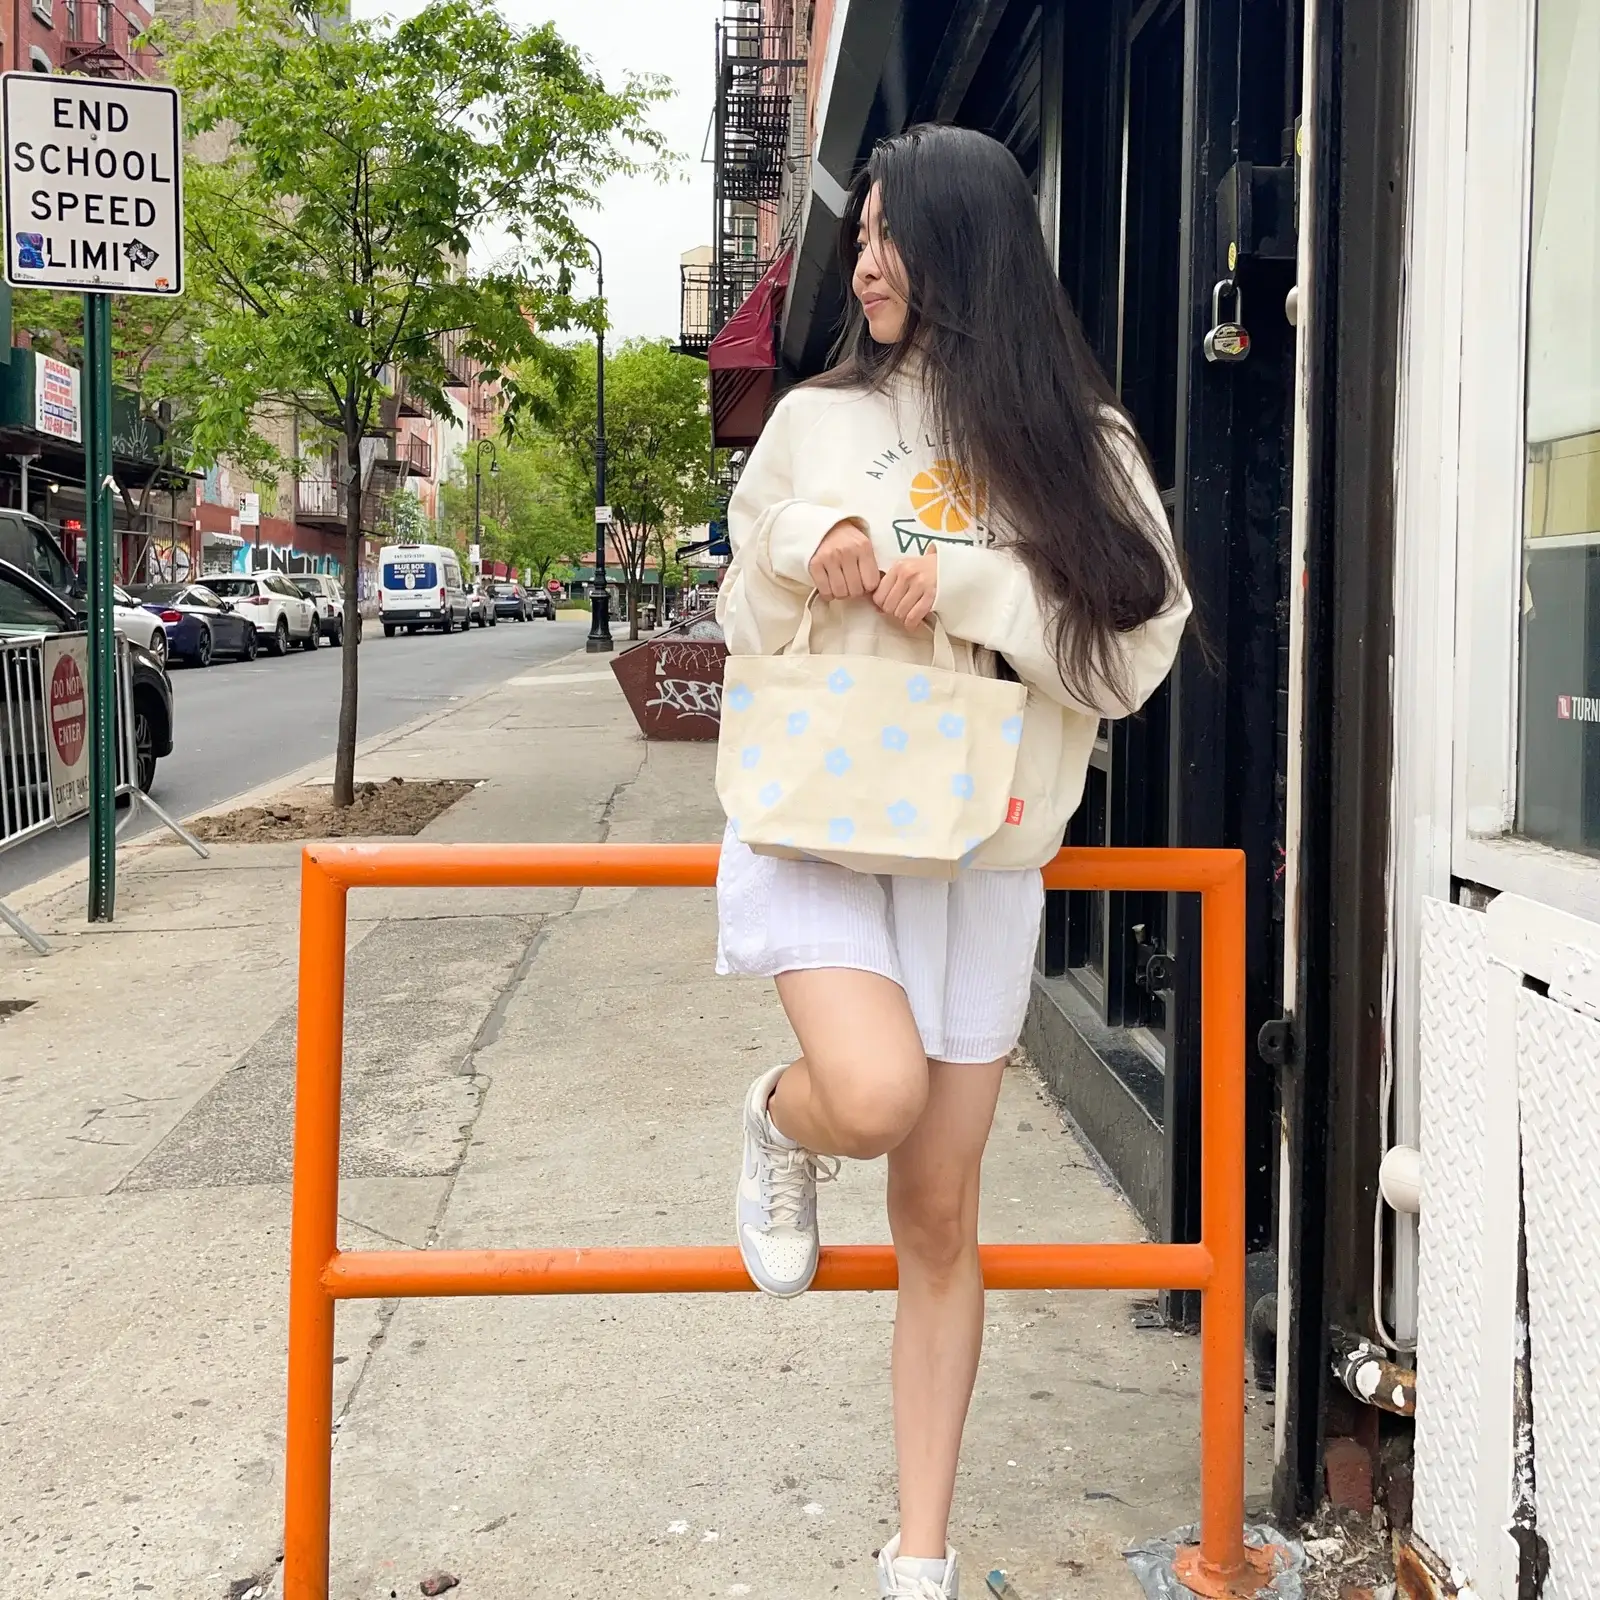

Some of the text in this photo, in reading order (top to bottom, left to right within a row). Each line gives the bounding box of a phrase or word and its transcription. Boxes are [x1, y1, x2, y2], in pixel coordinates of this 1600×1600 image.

[53, 97, 129, 132] END
[14, 141, 171, 184] SCHOOL
[30, 190, 156, 227] SPEED
[54, 676, 80, 699] DO NOT
[1571, 696, 1600, 723] TURN
[58, 722, 81, 746] ENTER
[55, 780, 75, 804] EXCEPT
